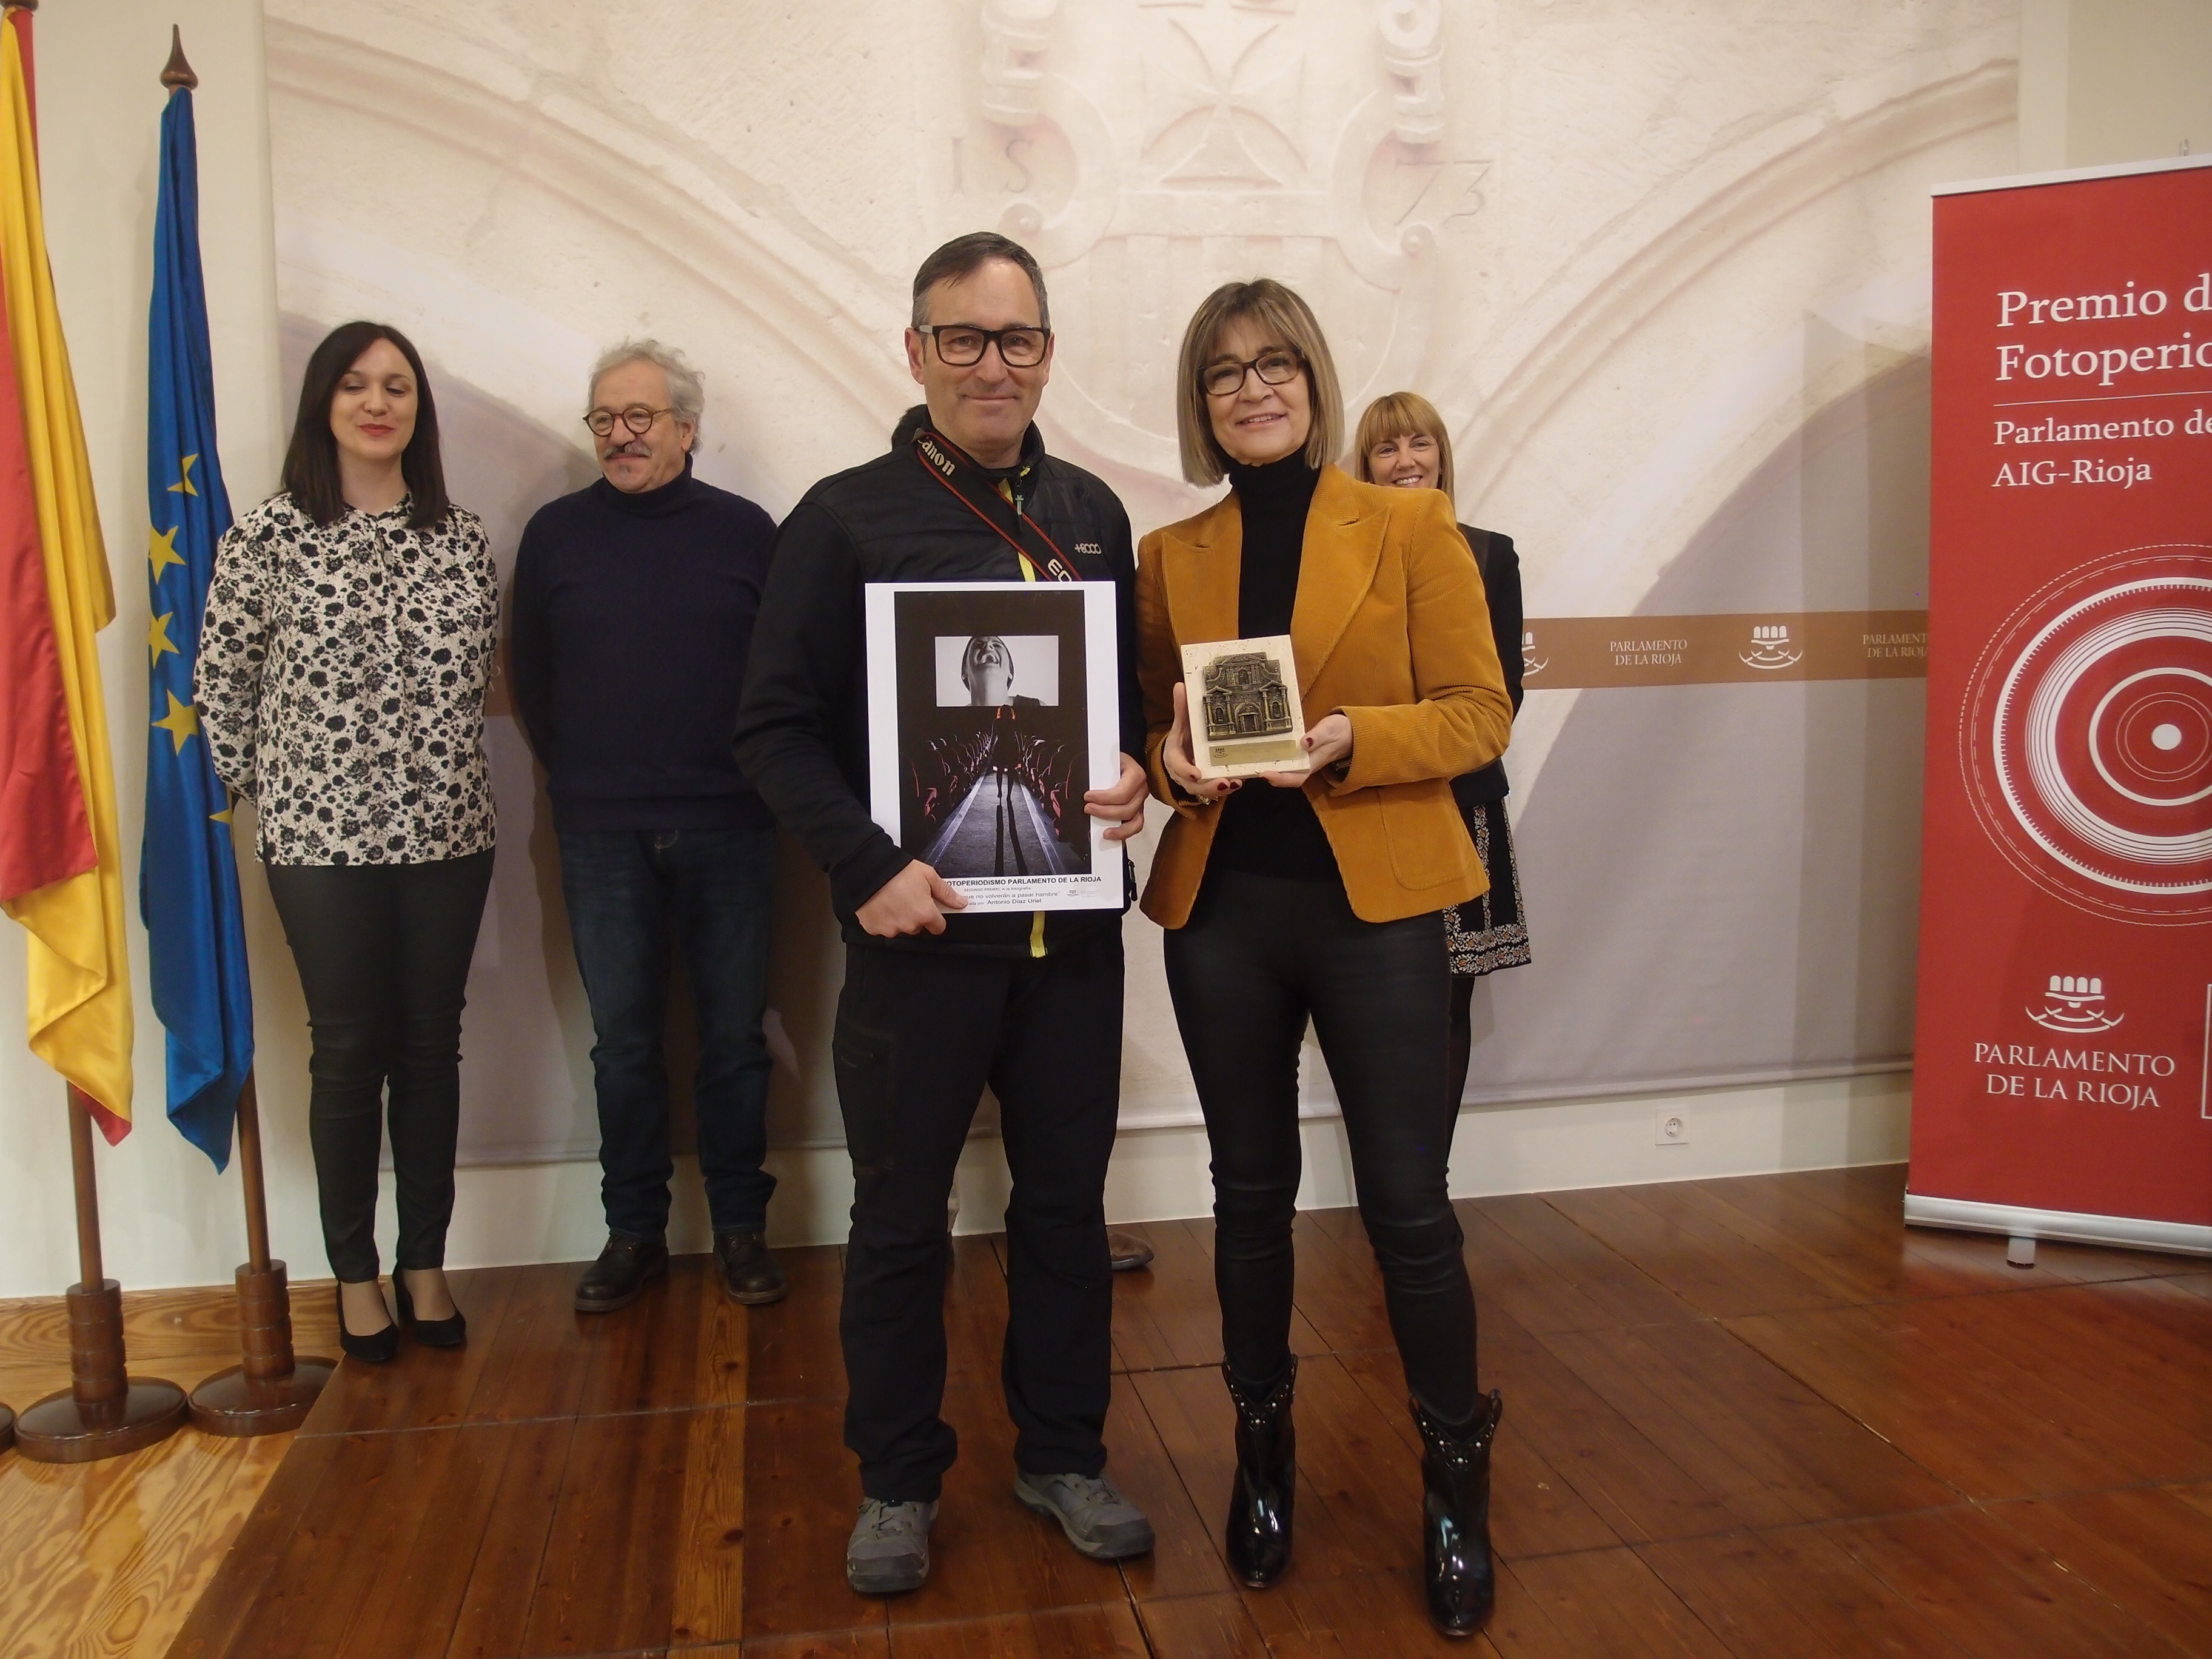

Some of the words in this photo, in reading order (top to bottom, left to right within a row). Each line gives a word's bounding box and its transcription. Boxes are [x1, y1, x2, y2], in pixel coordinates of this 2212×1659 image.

[1996, 280, 2167, 327] Premio
[1996, 332, 2212, 386] Fotoperio
[1993, 417, 2174, 445] Parlamento
[917, 440, 956, 476] anon
[1991, 457, 2153, 489] AIG-Rioja
[1609, 639, 1687, 652] PARLAMENTO
[1615, 654, 1632, 665] DE
[1635, 654, 1649, 665] LA
[1651, 653, 1682, 666] RIOJA
[1868, 648, 1883, 658] DE
[1885, 647, 1898, 657] LA
[1901, 646, 1928, 659] RIOJ
[1974, 1042, 2176, 1077] PARLAMENTO
[1986, 1074, 2025, 1096] DE
[2034, 1078, 2068, 1100] LA
[2077, 1081, 2161, 1111] RIOJA
